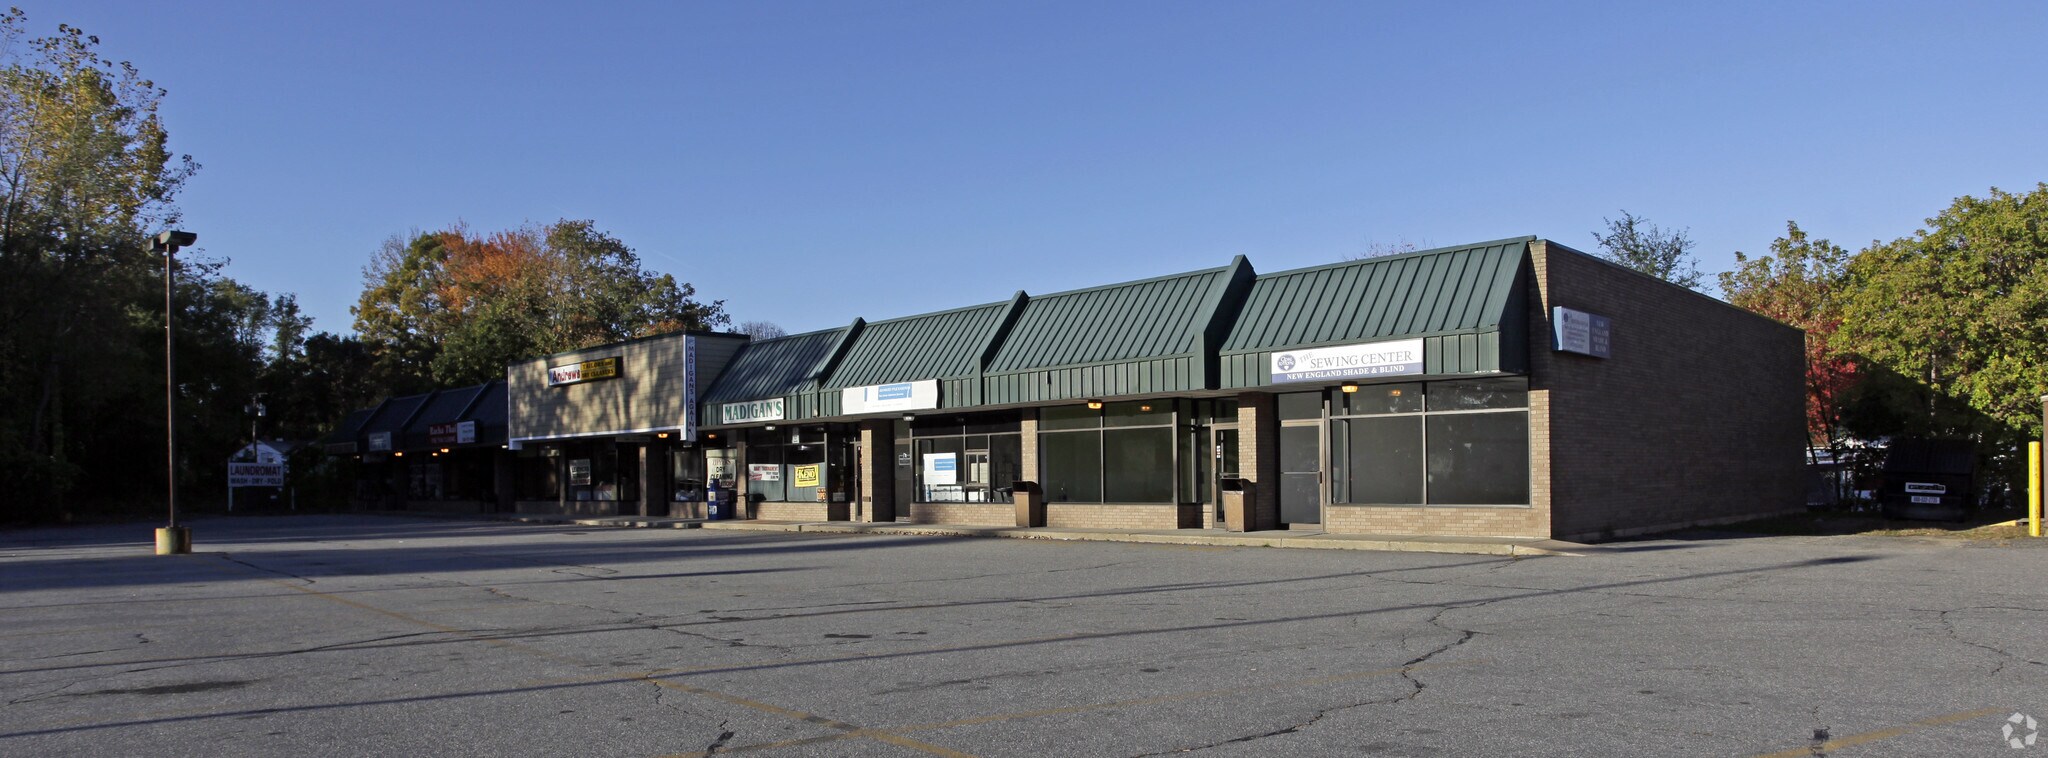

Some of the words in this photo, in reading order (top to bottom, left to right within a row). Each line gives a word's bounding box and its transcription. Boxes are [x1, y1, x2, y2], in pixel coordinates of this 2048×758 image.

[1299, 352, 1313, 363] THE
[1311, 355, 1358, 369] SEWING
[1361, 351, 1413, 364] CENTER
[1306, 370, 1341, 378] ENGLAND
[1344, 367, 1370, 376] SHADE
[1380, 364, 1405, 373] BLIND
[725, 401, 782, 421] MADIGAN'S
[230, 466, 282, 476] LAUNDROMAT
[798, 469, 816, 479] KENO
